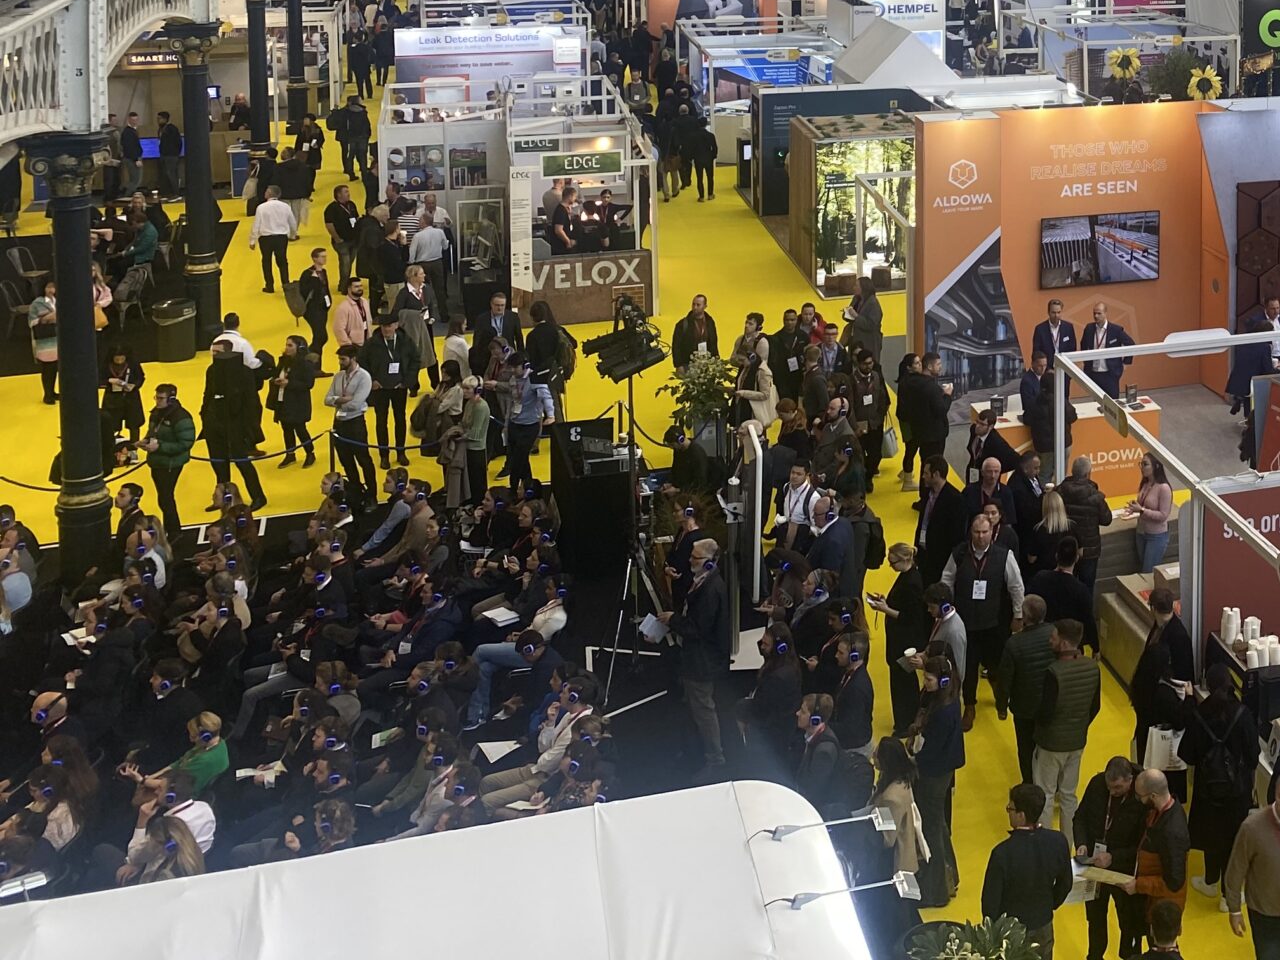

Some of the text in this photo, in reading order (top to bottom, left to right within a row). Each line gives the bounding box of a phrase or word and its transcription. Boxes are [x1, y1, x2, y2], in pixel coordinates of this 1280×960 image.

[887, 2, 939, 14] HEMPEL
[418, 32, 540, 45] Leak Detection Solutions
[131, 54, 163, 63] SMART
[1050, 139, 1148, 160] THOSE WHO
[564, 155, 601, 170] EDGE
[1030, 157, 1168, 181] REALISE DREAMS
[1060, 180, 1138, 199] ARE SEEN
[932, 192, 993, 209] ALDOWA
[531, 258, 641, 291] VELOX
[1082, 447, 1144, 465] LDOWA
